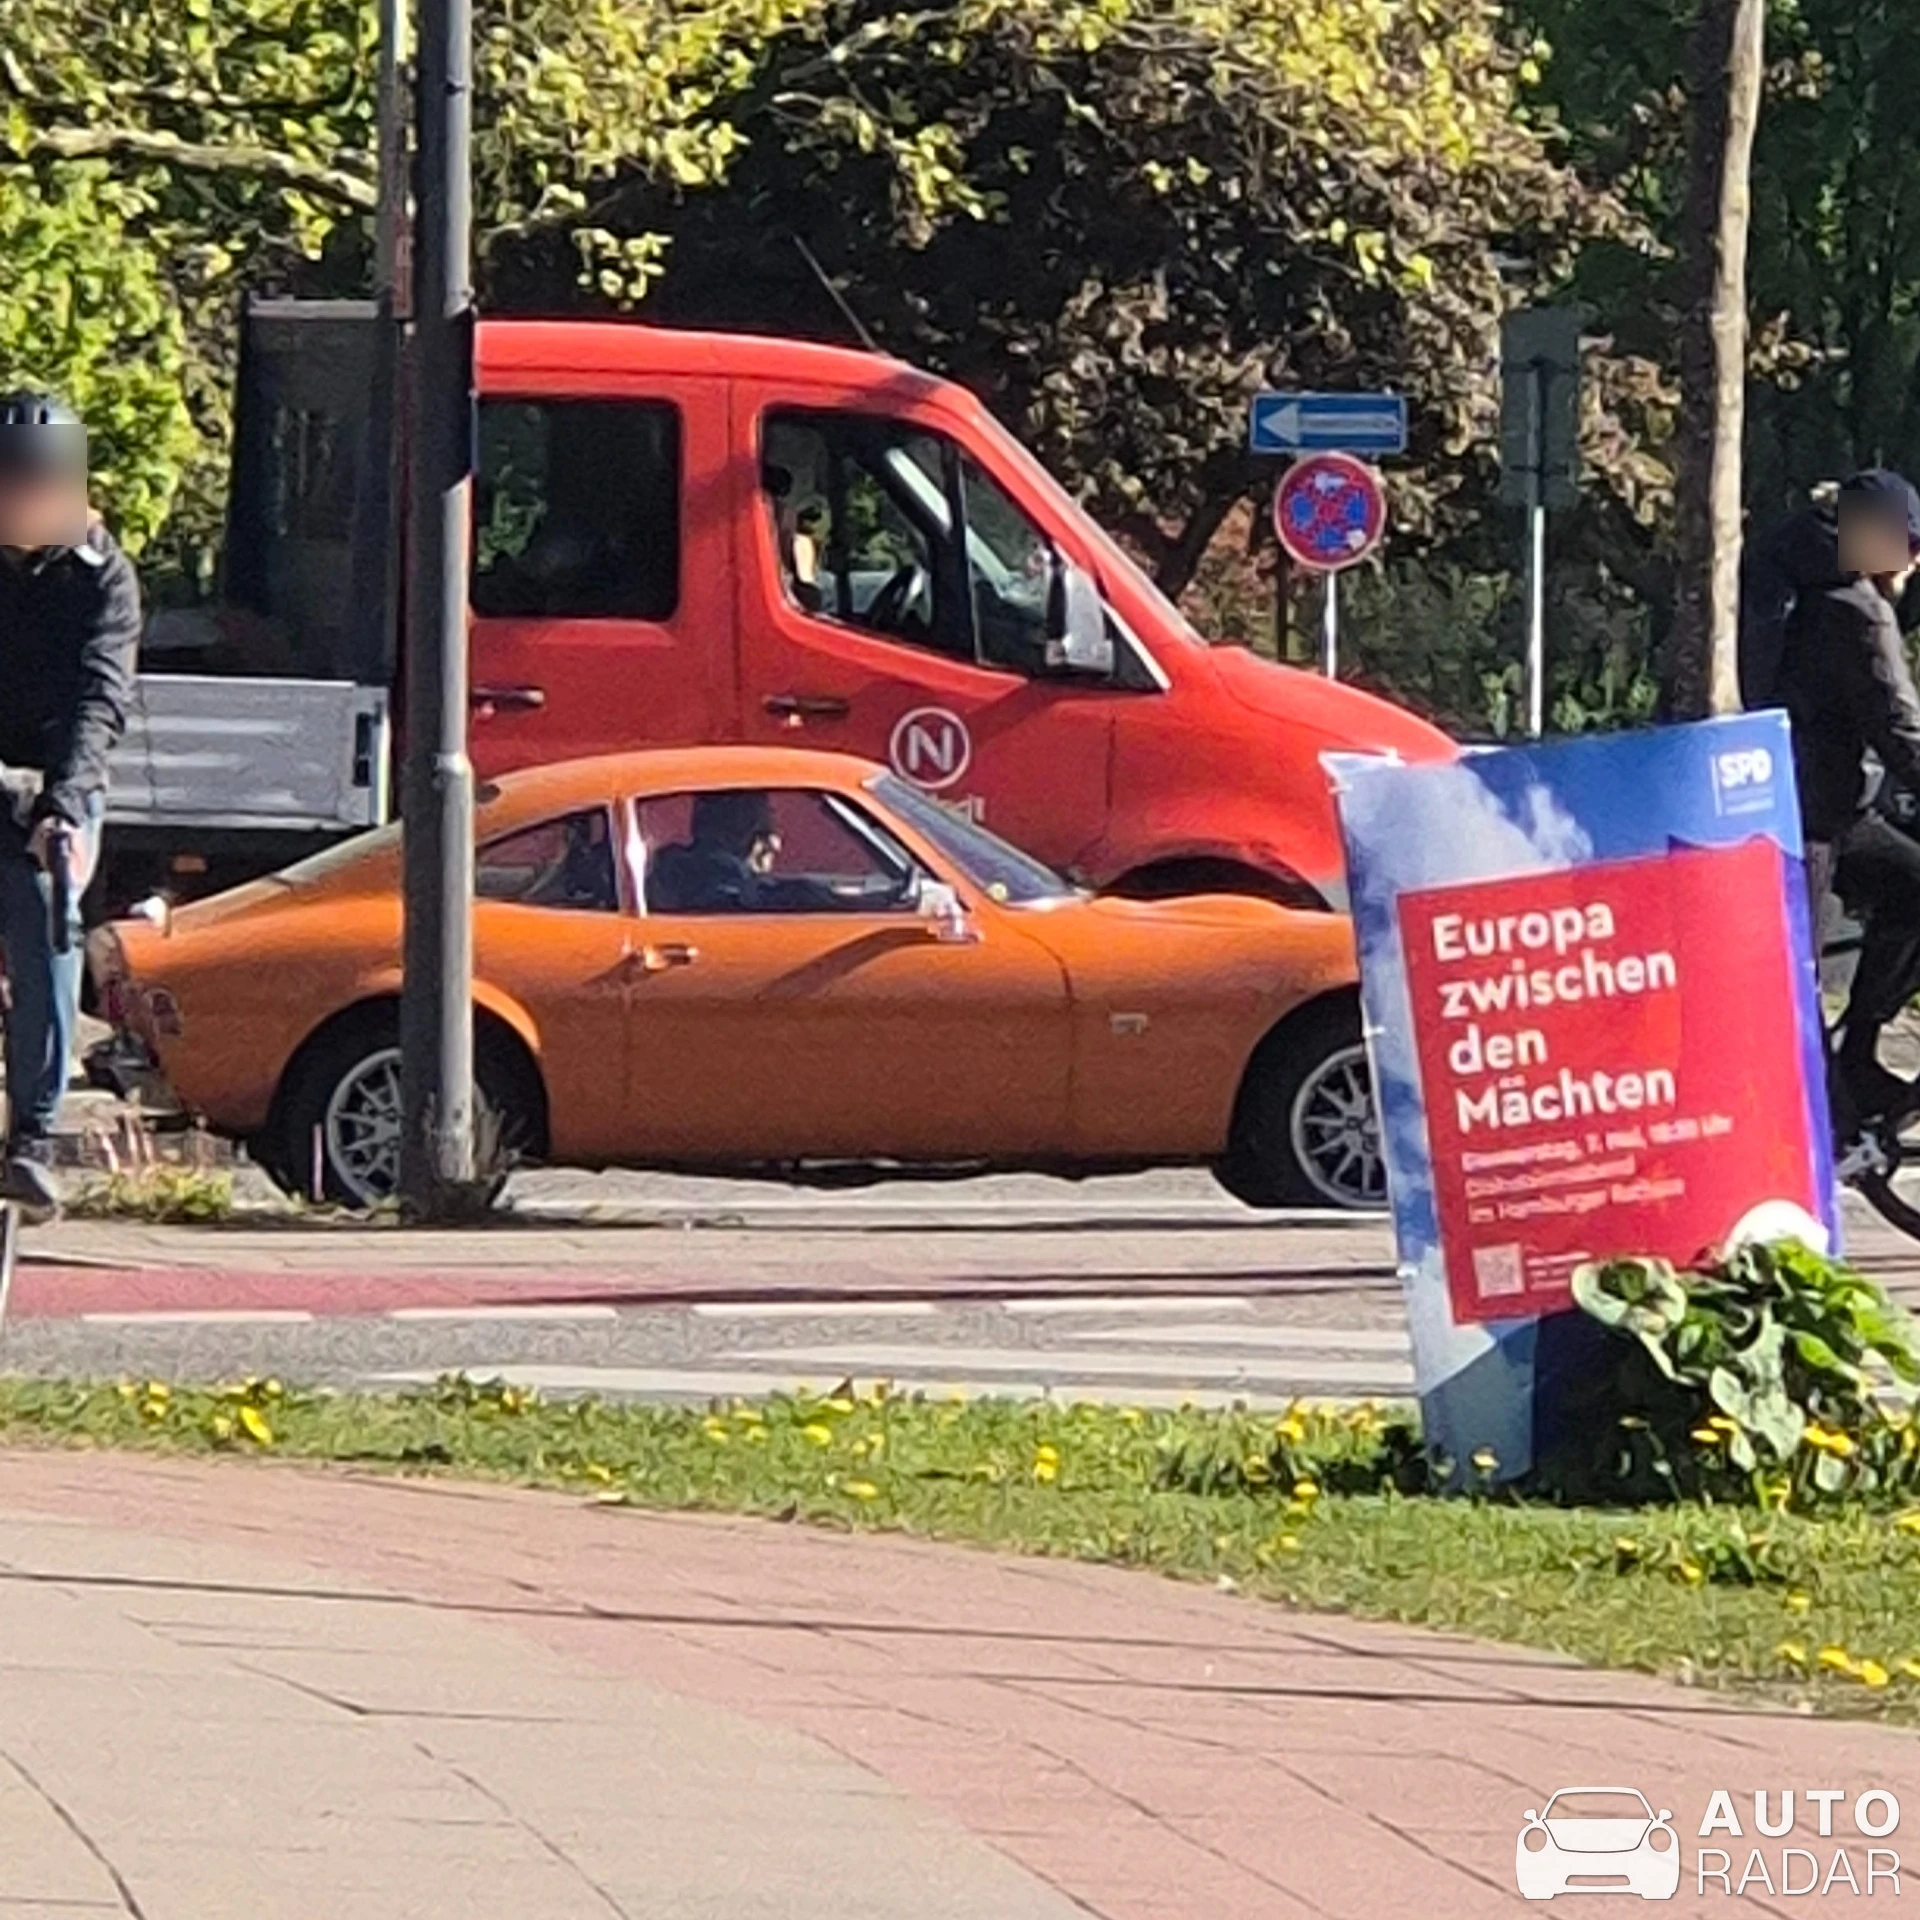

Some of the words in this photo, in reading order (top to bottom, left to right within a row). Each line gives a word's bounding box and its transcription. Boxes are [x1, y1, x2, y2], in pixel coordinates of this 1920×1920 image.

[907, 724, 953, 772] N
[1719, 748, 1773, 788] SPD
[1433, 902, 1615, 962] Europa
[1438, 947, 1677, 1018] zwischen
[1449, 1022, 1549, 1075] den
[1455, 1067, 1677, 1134] Mächten
